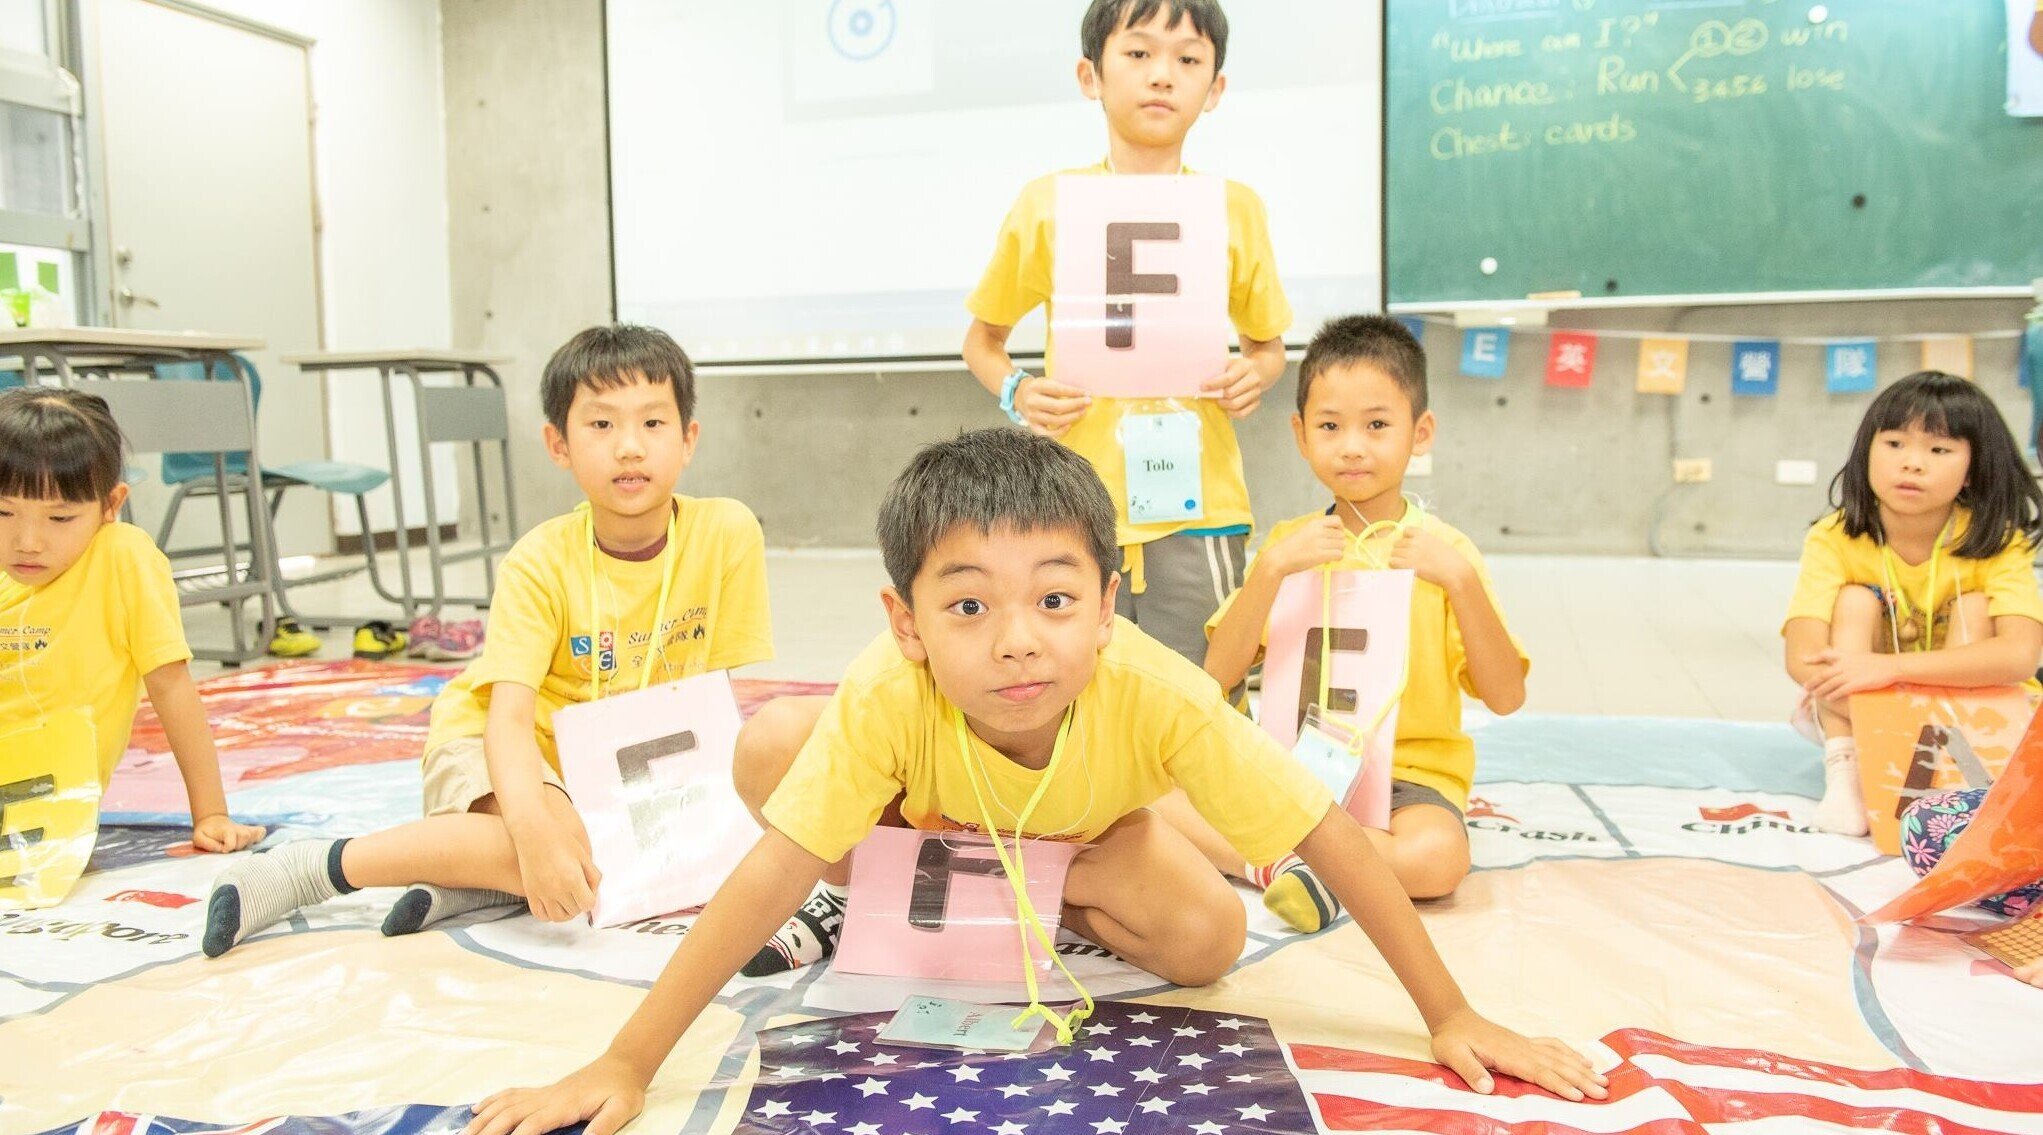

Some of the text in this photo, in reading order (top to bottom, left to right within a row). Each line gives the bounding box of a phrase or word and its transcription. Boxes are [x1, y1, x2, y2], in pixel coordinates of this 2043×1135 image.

[1597, 55, 1660, 95] Run
[1787, 63, 1846, 91] lose
[1544, 112, 1637, 144] cards
[1106, 222, 1180, 348] F
[1473, 333, 1499, 362] E
[1143, 459, 1174, 472] Tolo
